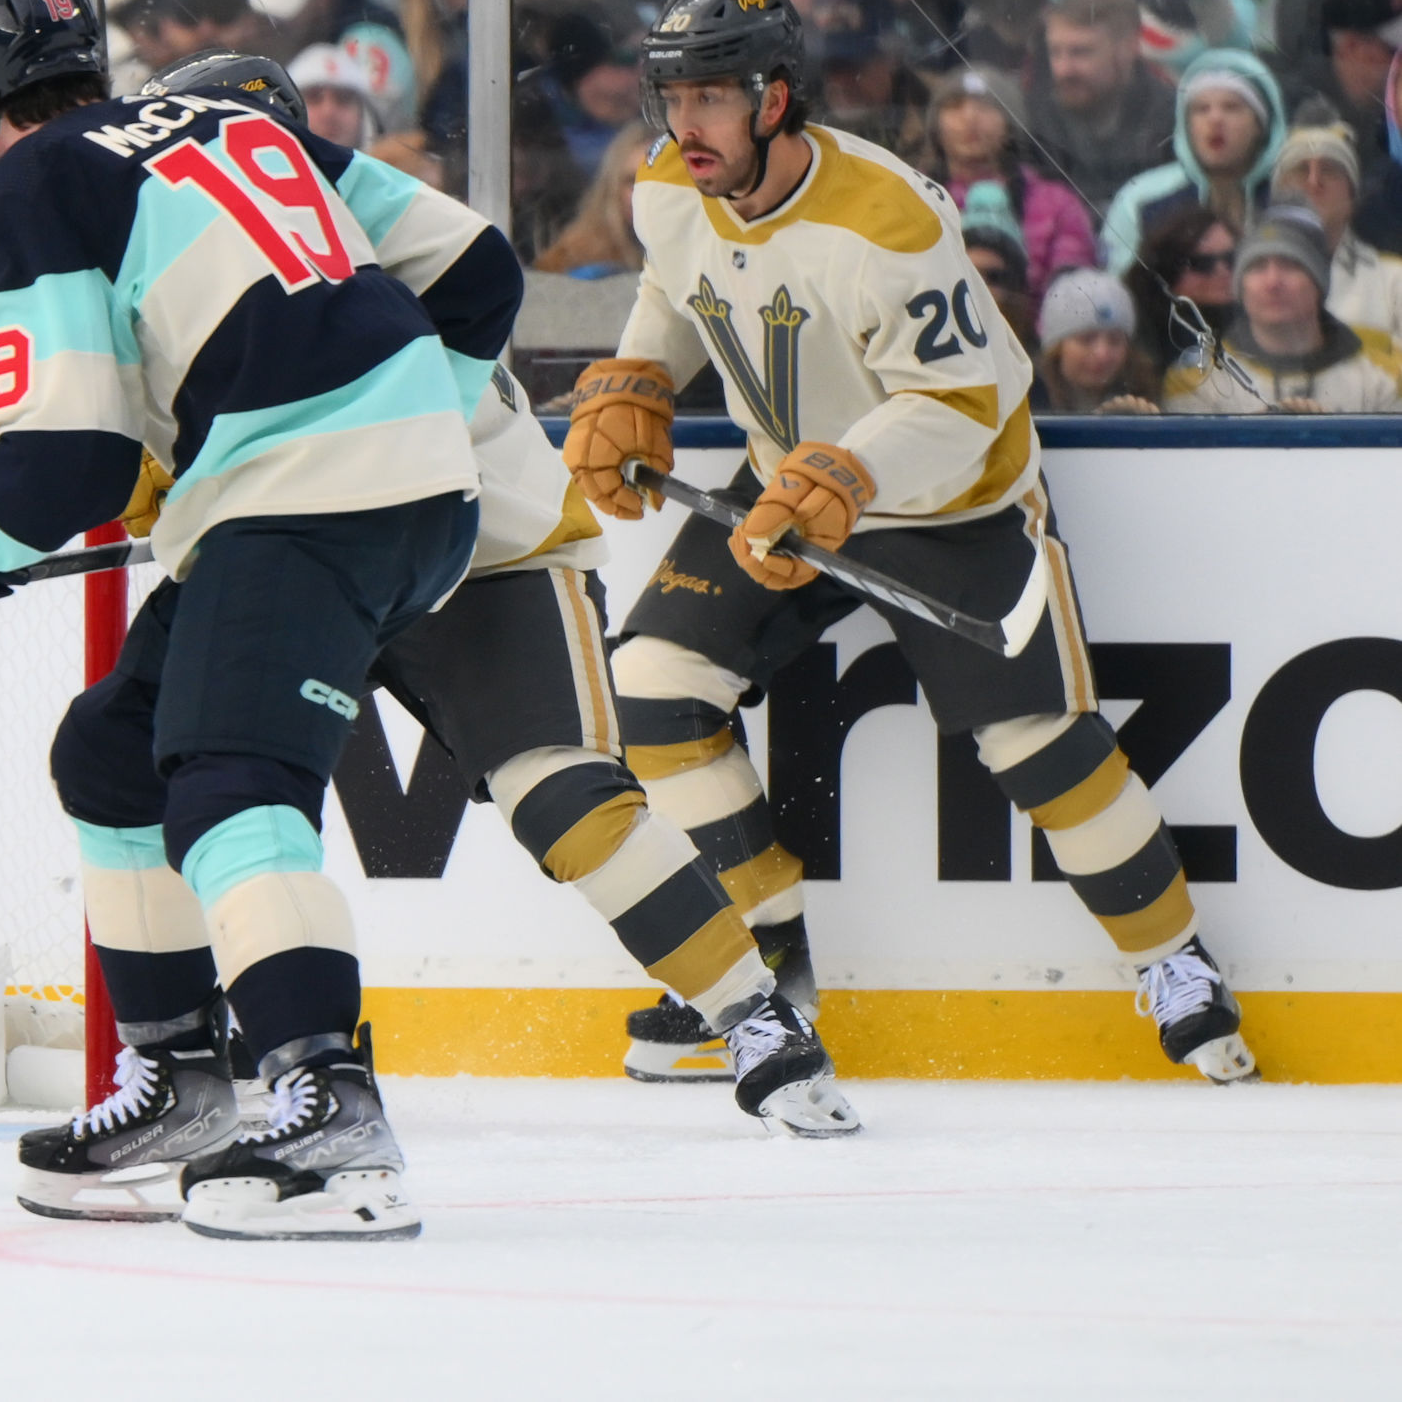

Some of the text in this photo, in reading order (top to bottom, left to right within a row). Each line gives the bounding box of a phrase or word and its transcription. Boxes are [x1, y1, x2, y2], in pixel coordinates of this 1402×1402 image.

[143, 112, 357, 296] 19
[905, 278, 988, 366] 20
[110, 1124, 165, 1162] BAUER
[274, 1129, 325, 1161] BAUER
